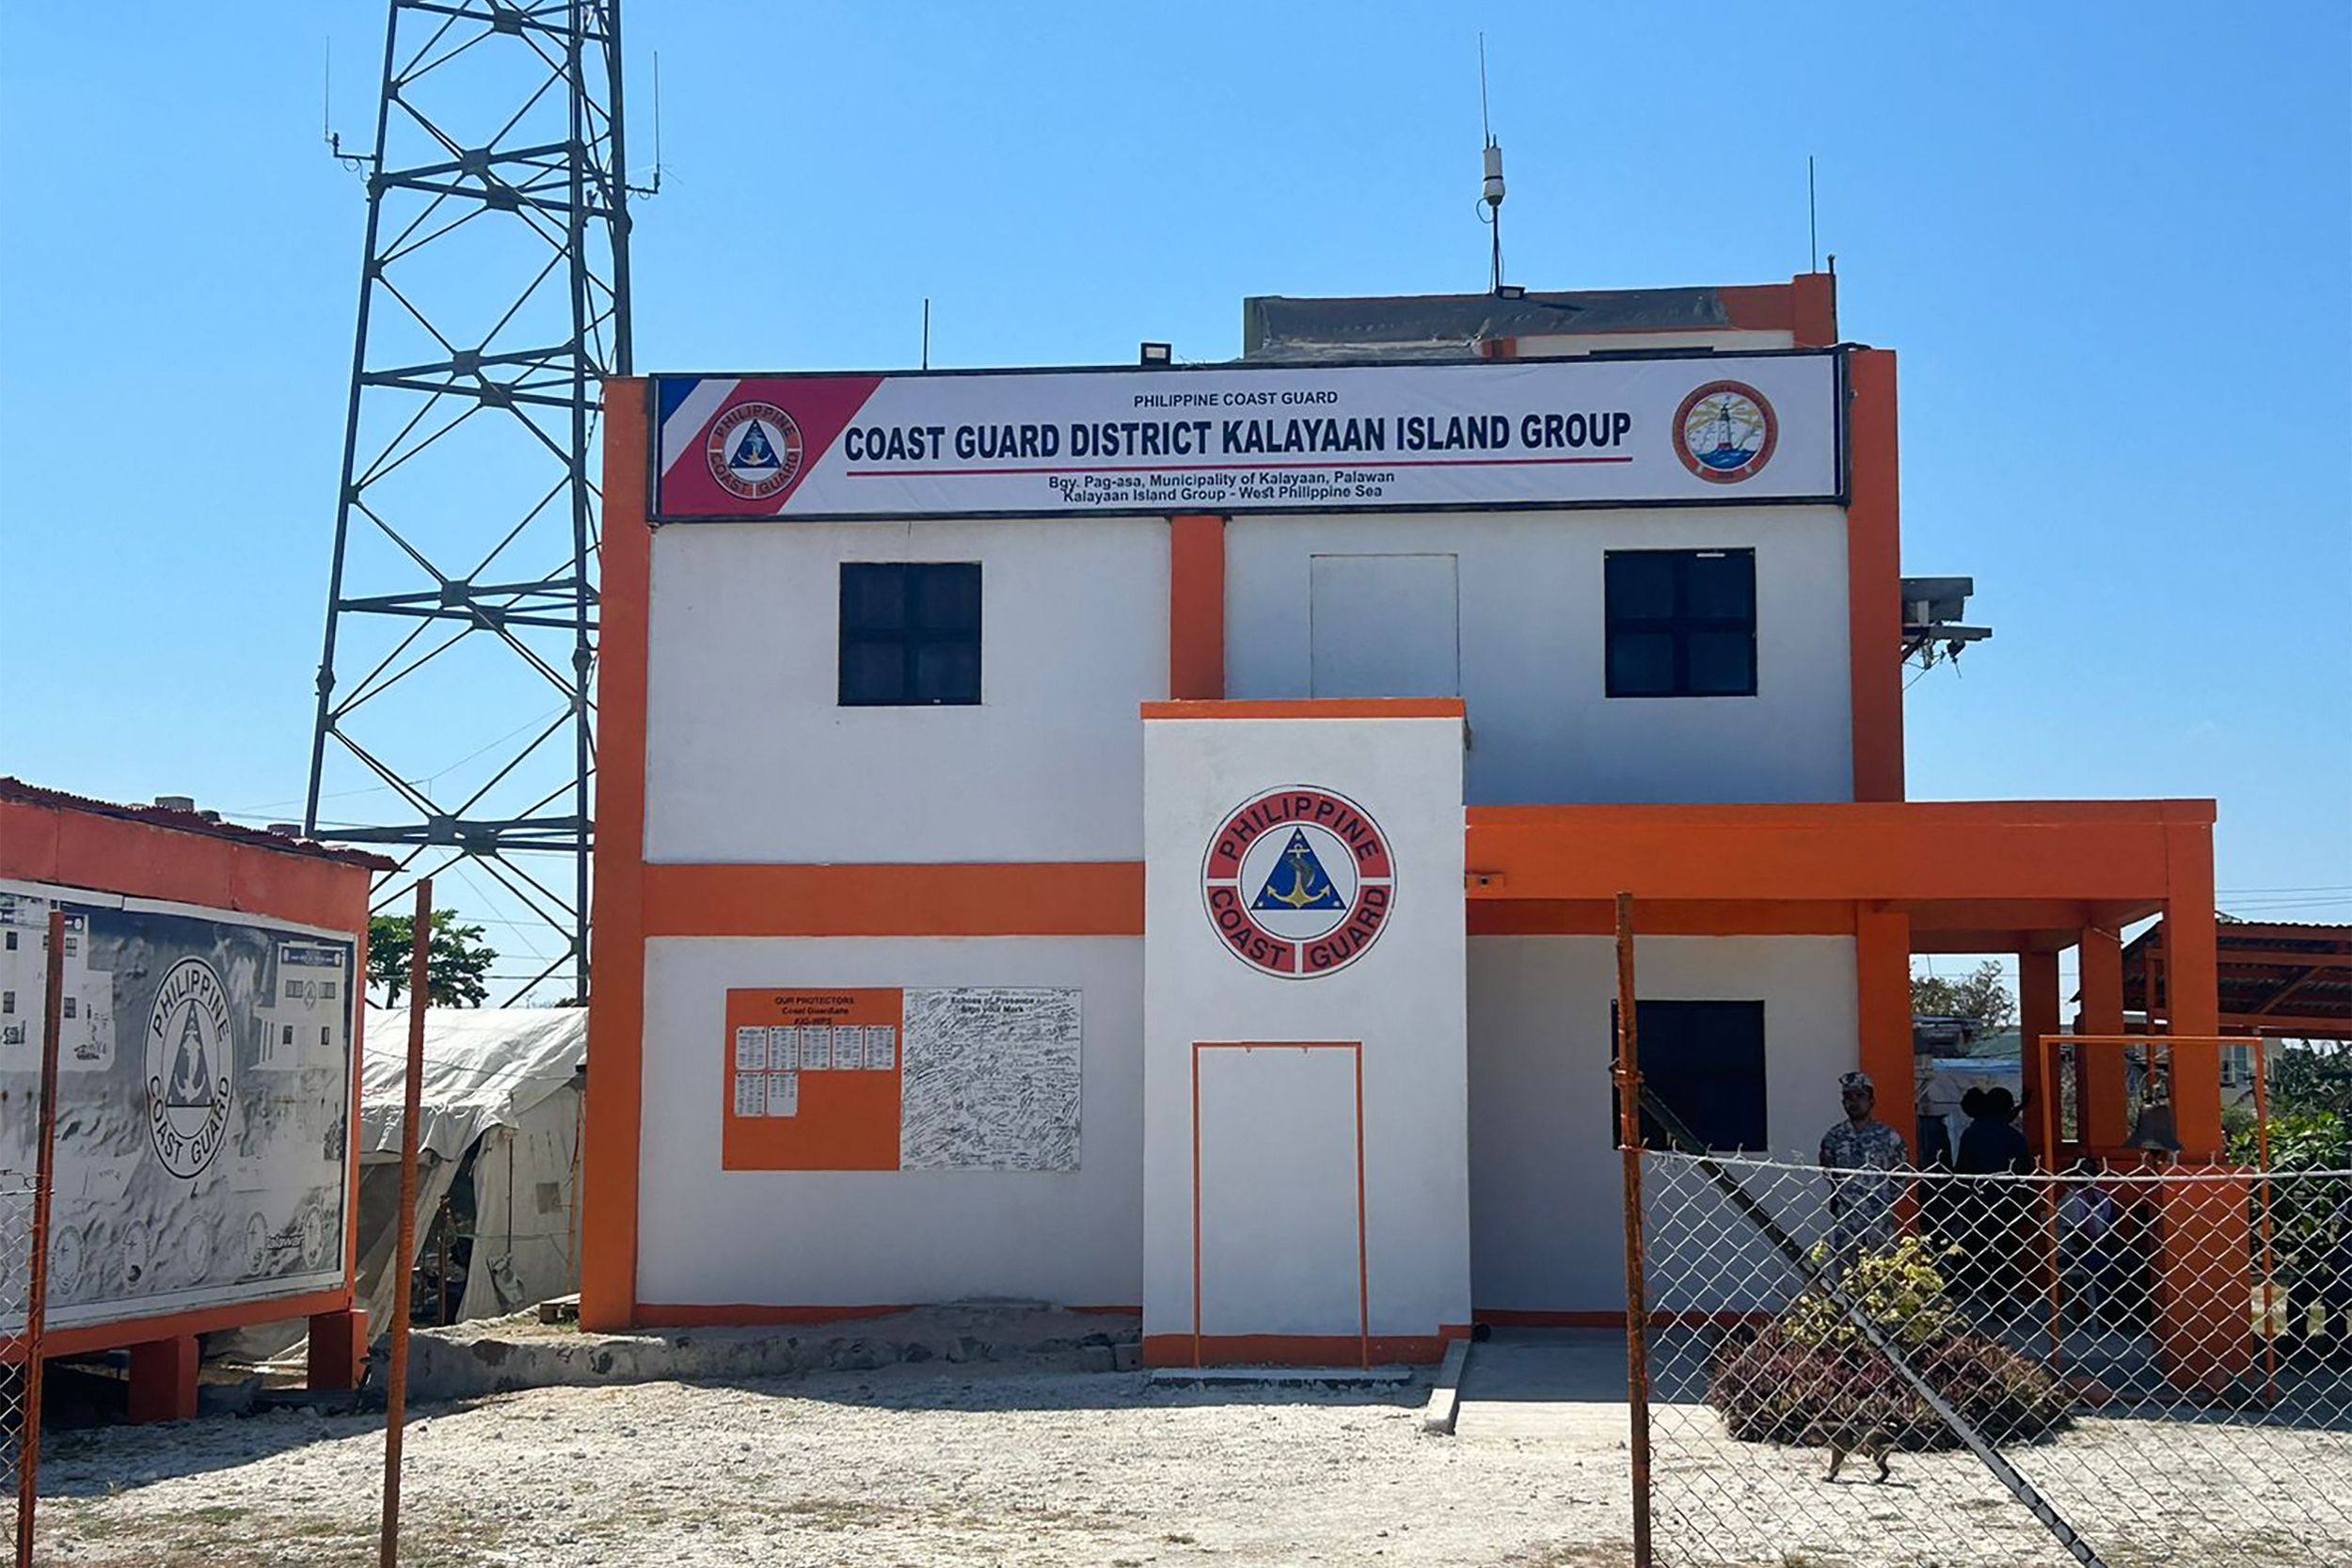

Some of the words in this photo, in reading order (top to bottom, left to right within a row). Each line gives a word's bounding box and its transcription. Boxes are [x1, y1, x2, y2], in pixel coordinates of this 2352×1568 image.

[714, 404, 797, 436] PHILIPPINE
[1134, 393, 1218, 407] PHILIPPINE
[1223, 392, 1278, 406] COAST
[1281, 391, 1338, 404] GUARD
[845, 426, 945, 461] COAST
[955, 424, 1059, 459] GUARD
[1071, 421, 1212, 457] DISTRICT
[1222, 418, 1385, 453] KALAYAAN
[1397, 415, 1510, 451] ISLAND
[1521, 412, 1631, 449] GROUP
[710, 452, 751, 496] COAST
[759, 452, 799, 493] GUARD
[1063, 489, 1128, 504] Kalayaan
[1134, 489, 1176, 501] Island
[1181, 488, 1226, 502] Group
[1239, 486, 1275, 499] West
[1279, 485, 1351, 500] Philippine
[1355, 484, 1382, 497] Sea
[1085, 475, 1145, 490] Pag-asa,
[1151, 473, 1236, 488] Municipality
[1241, 472, 1255, 484] of
[1260, 472, 1329, 487] Kalayaan,
[1334, 471, 1394, 483] Palawan
[1219, 797, 1379, 862] PHILIPPINE
[1212, 889, 1287, 966] COAST
[1310, 888, 1386, 968] GUARD
[152, 969, 230, 1042] PHILIPPINE
[796, 996, 854, 1005] PROTECTORS
[150, 1075, 183, 1164] COAST
[191, 1077, 229, 1164] GUARD
